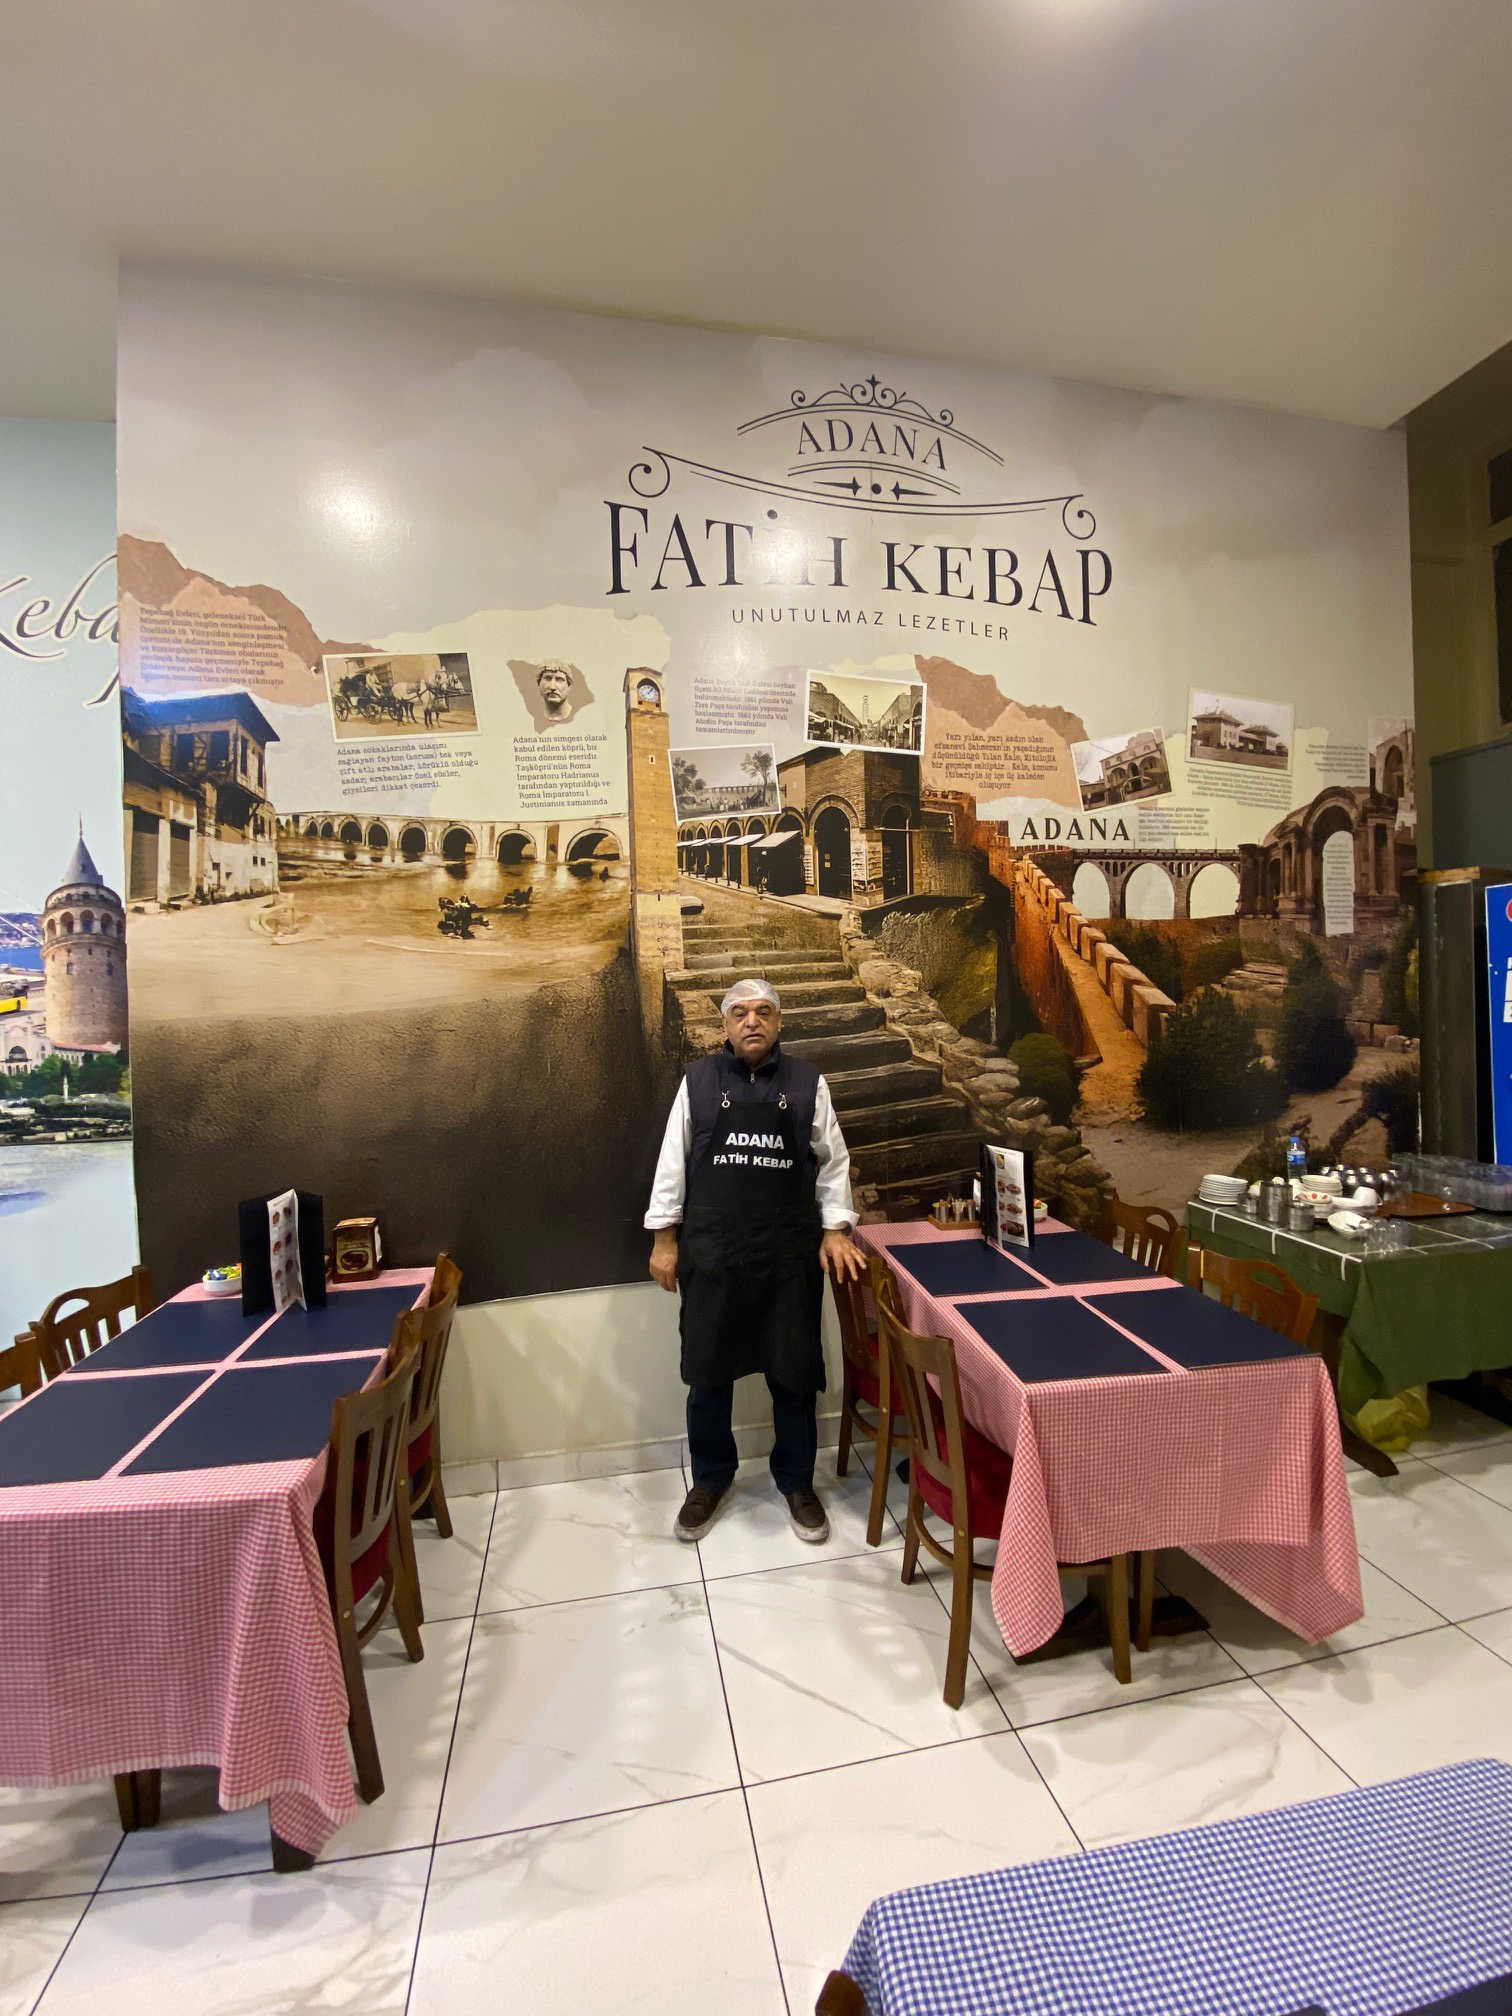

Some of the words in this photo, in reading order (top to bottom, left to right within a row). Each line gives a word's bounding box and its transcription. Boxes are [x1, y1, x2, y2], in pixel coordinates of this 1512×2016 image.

[797, 418, 948, 471] ADANA
[881, 541, 1113, 627] KEBAP
[732, 608, 884, 626] UNUTULMAZ
[898, 613, 1010, 641] LEZETLER
[1020, 817, 1131, 841] ADANA
[726, 1132, 784, 1150] ADANA
[713, 1152, 748, 1165] FATİH
[753, 1155, 794, 1169] KEBAP
